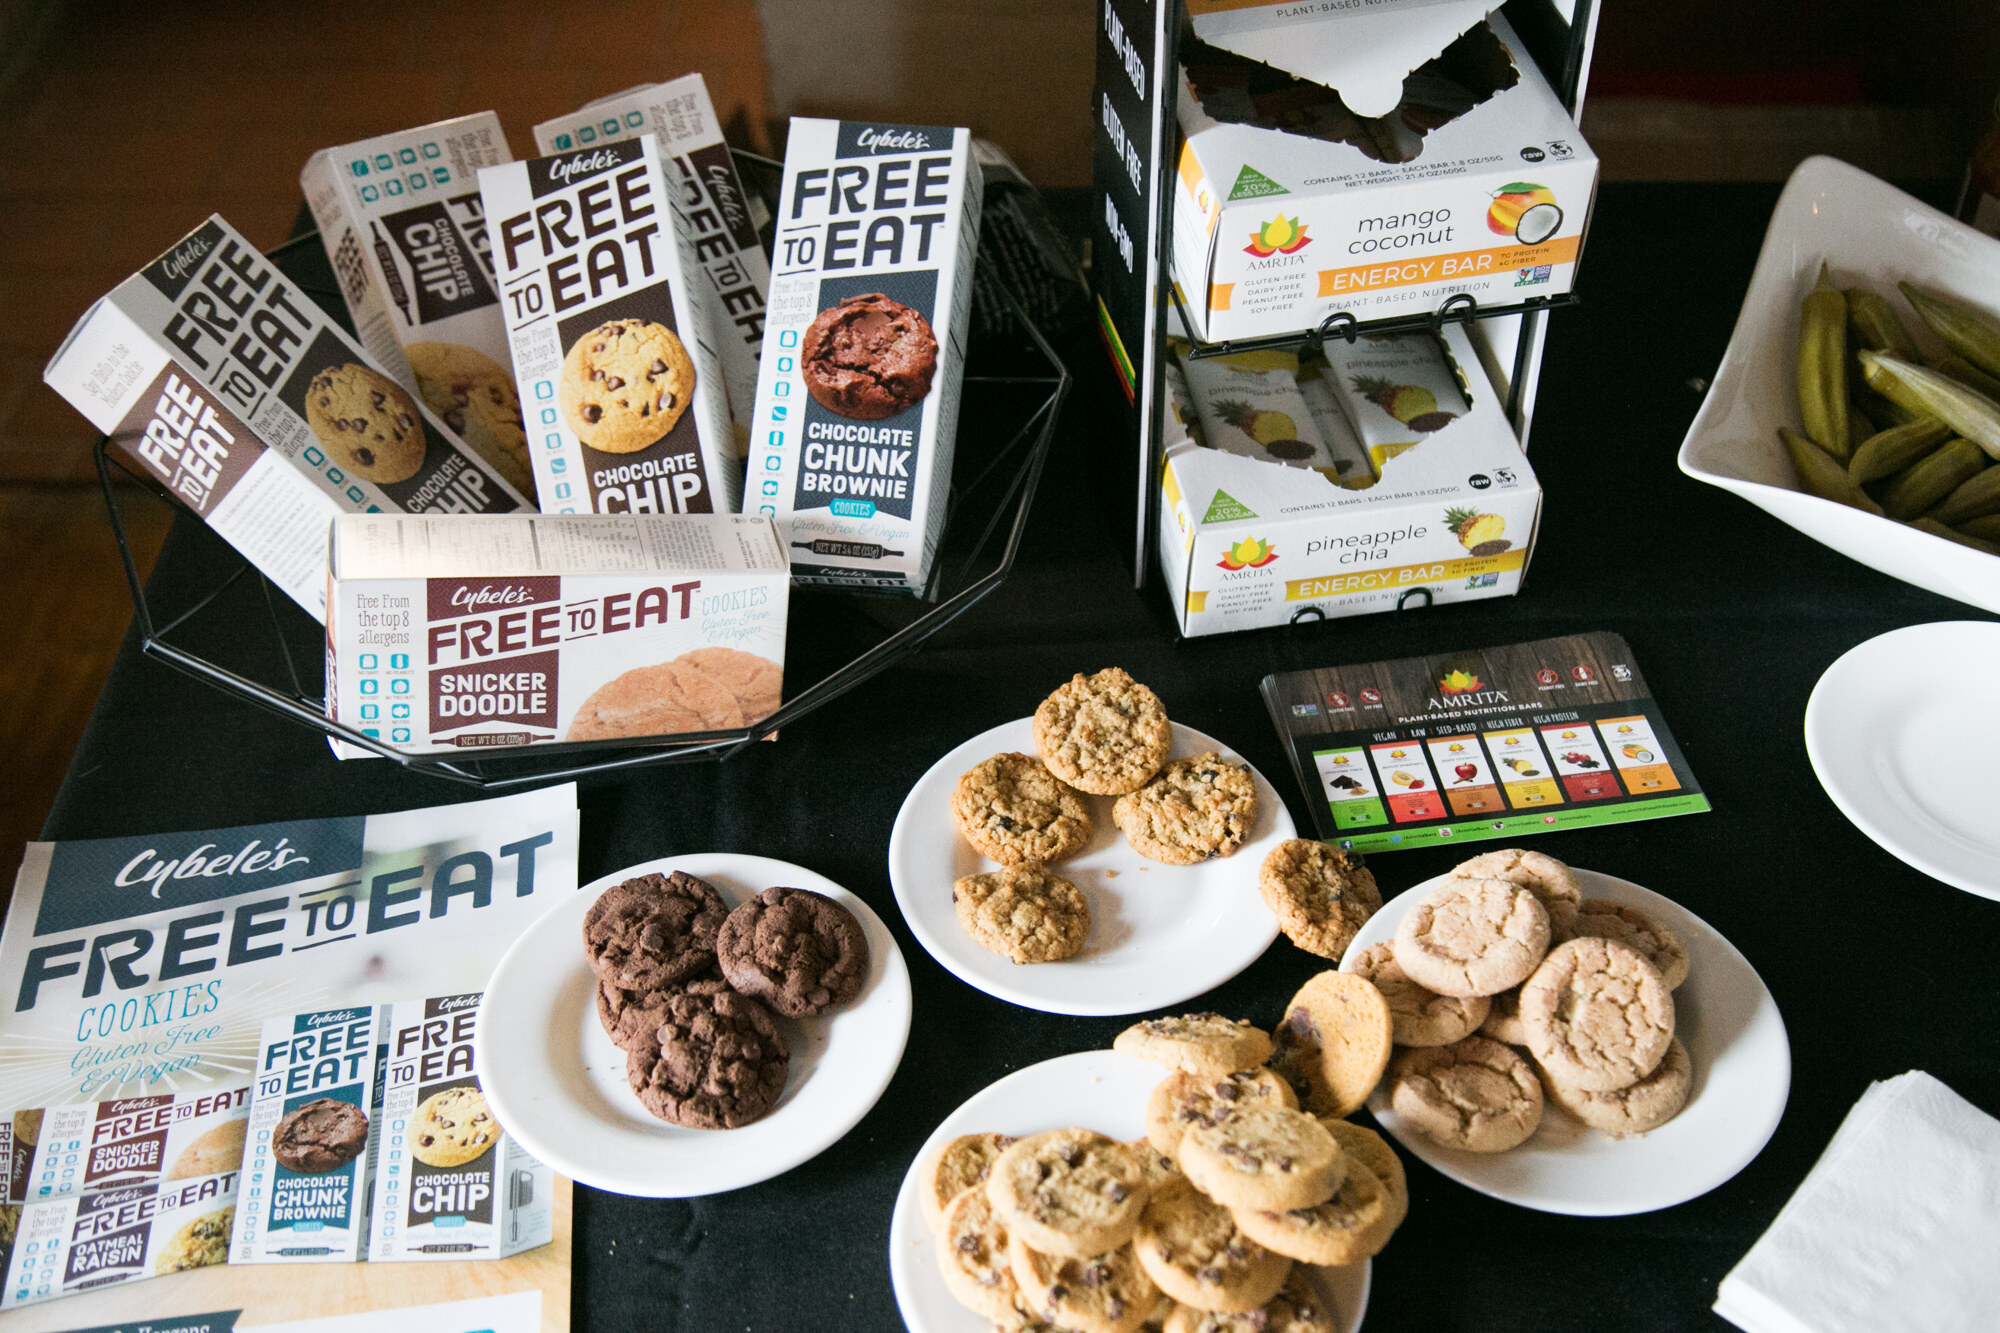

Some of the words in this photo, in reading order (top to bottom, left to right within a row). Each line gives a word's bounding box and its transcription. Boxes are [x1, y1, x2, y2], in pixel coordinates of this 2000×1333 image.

[1276, 0, 1361, 18] PLANT-BASED
[857, 128, 930, 154] Cybele's
[550, 149, 622, 184] Cybele's
[1126, 139, 1142, 196] FREE
[1304, 175, 1352, 186] CONTAINS
[1368, 169, 1393, 177] BARS
[1402, 164, 1428, 173] EACH
[1430, 161, 1449, 169] BAR
[1467, 155, 1503, 165] OZ/50G
[1345, 180, 1364, 188] NET
[1366, 175, 1403, 185] WEIGHT:
[1405, 172, 1424, 180] 21.6
[1426, 167, 1467, 177] OZ/600G
[709, 165, 744, 231] Cybele's
[792, 157, 952, 219] FREE
[1242, 182, 1271, 191] 20%
[1256, 187, 1287, 196] SUGAR
[501, 165, 655, 271] FREE
[1359, 208, 1452, 233] mango
[783, 237, 816, 266] TO
[823, 213, 946, 271] EAT
[1348, 226, 1454, 254] coconut
[1514, 247, 1550, 258] PROTEIN
[162, 236, 213, 279] Cybele's
[405, 222, 460, 302] CHIP
[435, 218, 475, 297] CHOCOLATE
[547, 222, 659, 313] EAT
[1246, 254, 1305, 271] AMRITA
[1512, 256, 1536, 265] FIBER
[714, 260, 741, 288] TO
[1334, 262, 1435, 290] ENERGY
[1442, 254, 1492, 276] BAR
[509, 283, 543, 319] TO
[773, 281, 792, 295] Free
[1328, 291, 1416, 310] PLANT-BASED
[1423, 282, 1490, 298] NUTRITION
[163, 239, 271, 371] FREE
[773, 296, 788, 310] the
[789, 295, 805, 313] top
[770, 311, 810, 328] allergens
[230, 282, 312, 389] EAT
[220, 371, 257, 408] TO
[138, 373, 204, 477] FREE
[808, 422, 913, 447] CHOCOLATE
[181, 406, 235, 491] EAT
[805, 443, 911, 477] CHUNK
[406, 453, 467, 513] CHOCOLATE
[594, 453, 698, 488] CHOCOLATE
[1470, 477, 1490, 487] raw
[178, 474, 203, 502] TO
[598, 473, 702, 514] CHIP
[803, 473, 907, 499] BROWNIE
[1281, 503, 1325, 514] CONTAINS
[1338, 498, 1362, 506] BARS
[1368, 494, 1392, 503] EACH
[1394, 492, 1413, 500] BAR
[1427, 486, 1460, 495] OZ/50G
[834, 501, 871, 518] COOKIES
[1216, 507, 1241, 516] 20%
[791, 517, 826, 534] Gluten
[827, 521, 857, 536] Free
[875, 526, 911, 542] Vegan
[1306, 524, 1427, 555] pineapple
[815, 542, 829, 552] NET
[830, 543, 842, 553] WT
[1339, 546, 1388, 564] chia
[1219, 568, 1273, 582] AMRITA
[1299, 572, 1392, 596] ENERGY
[1398, 564, 1445, 583] BAR
[357, 594, 379, 609] Free
[382, 594, 410, 608] From
[451, 585, 534, 613] Cybele's
[702, 585, 768, 617] COOKIES
[358, 610, 378, 627] the
[381, 612, 400, 630] top
[402, 610, 410, 626] 8
[428, 605, 560, 665] FREE
[567, 608, 596, 632] TO
[603, 580, 701, 634] EAT
[701, 616, 736, 636] Gluten
[738, 609, 769, 625] Free
[724, 626, 762, 641] Vegan
[358, 630, 410, 647] allergens
[440, 672, 547, 693] SNICKER
[439, 693, 547, 717] DOODLE
[1398, 711, 1462, 723] PLANT-BASED
[1464, 706, 1516, 717] NUTRITION
[1518, 702, 1543, 710] BARS
[1428, 690, 1509, 710] AMRITA
[461, 736, 475, 746] NET
[476, 735, 490, 746] WT
[1373, 731, 1397, 742] VEGAN
[1410, 728, 1426, 738] RAW
[1436, 722, 1477, 735] SEED-BASED
[1486, 719, 1505, 729] HIGH
[1505, 718, 1525, 727] FIBER
[1532, 714, 1551, 724] HIGH
[1551, 711, 1579, 722] PROTEIN
[114, 838, 309, 899] Cybele's
[15, 897, 290, 1012] FREE
[301, 896, 355, 937] TO
[367, 831, 553, 934] EAT
[77, 979, 222, 1042] COOKIES
[307, 1010, 355, 1028] Cybele's
[71, 1041, 151, 1077] Gluten
[154, 1023, 223, 1055] Free
[265, 1020, 371, 1071] FREE
[110, 1054, 202, 1085] Vegan
[286, 1051, 368, 1095] EAT
[392, 1065, 415, 1084] TO
[260, 1078, 281, 1096] TO
[91, 1106, 173, 1145] FREE
[176, 1105, 192, 1119] TO
[194, 1087, 250, 1118] EAT
[111, 1098, 159, 1114] Cybele's
[92, 1151, 158, 1174] DOODLE
[96, 1140, 160, 1160] SNICKER
[277, 1175, 350, 1190] CHOCOLATE
[415, 1172, 490, 1187] CHOCOLATE
[72, 1197, 157, 1242] FREE
[160, 1195, 177, 1210] TO
[179, 1172, 237, 1207] EAT
[275, 1188, 348, 1208] CHUNK
[413, 1184, 490, 1213] CHIP
[273, 1205, 346, 1220] BROWNIE
[76, 1234, 144, 1257] OATMEAL
[72, 1246, 142, 1274] RAISIN
